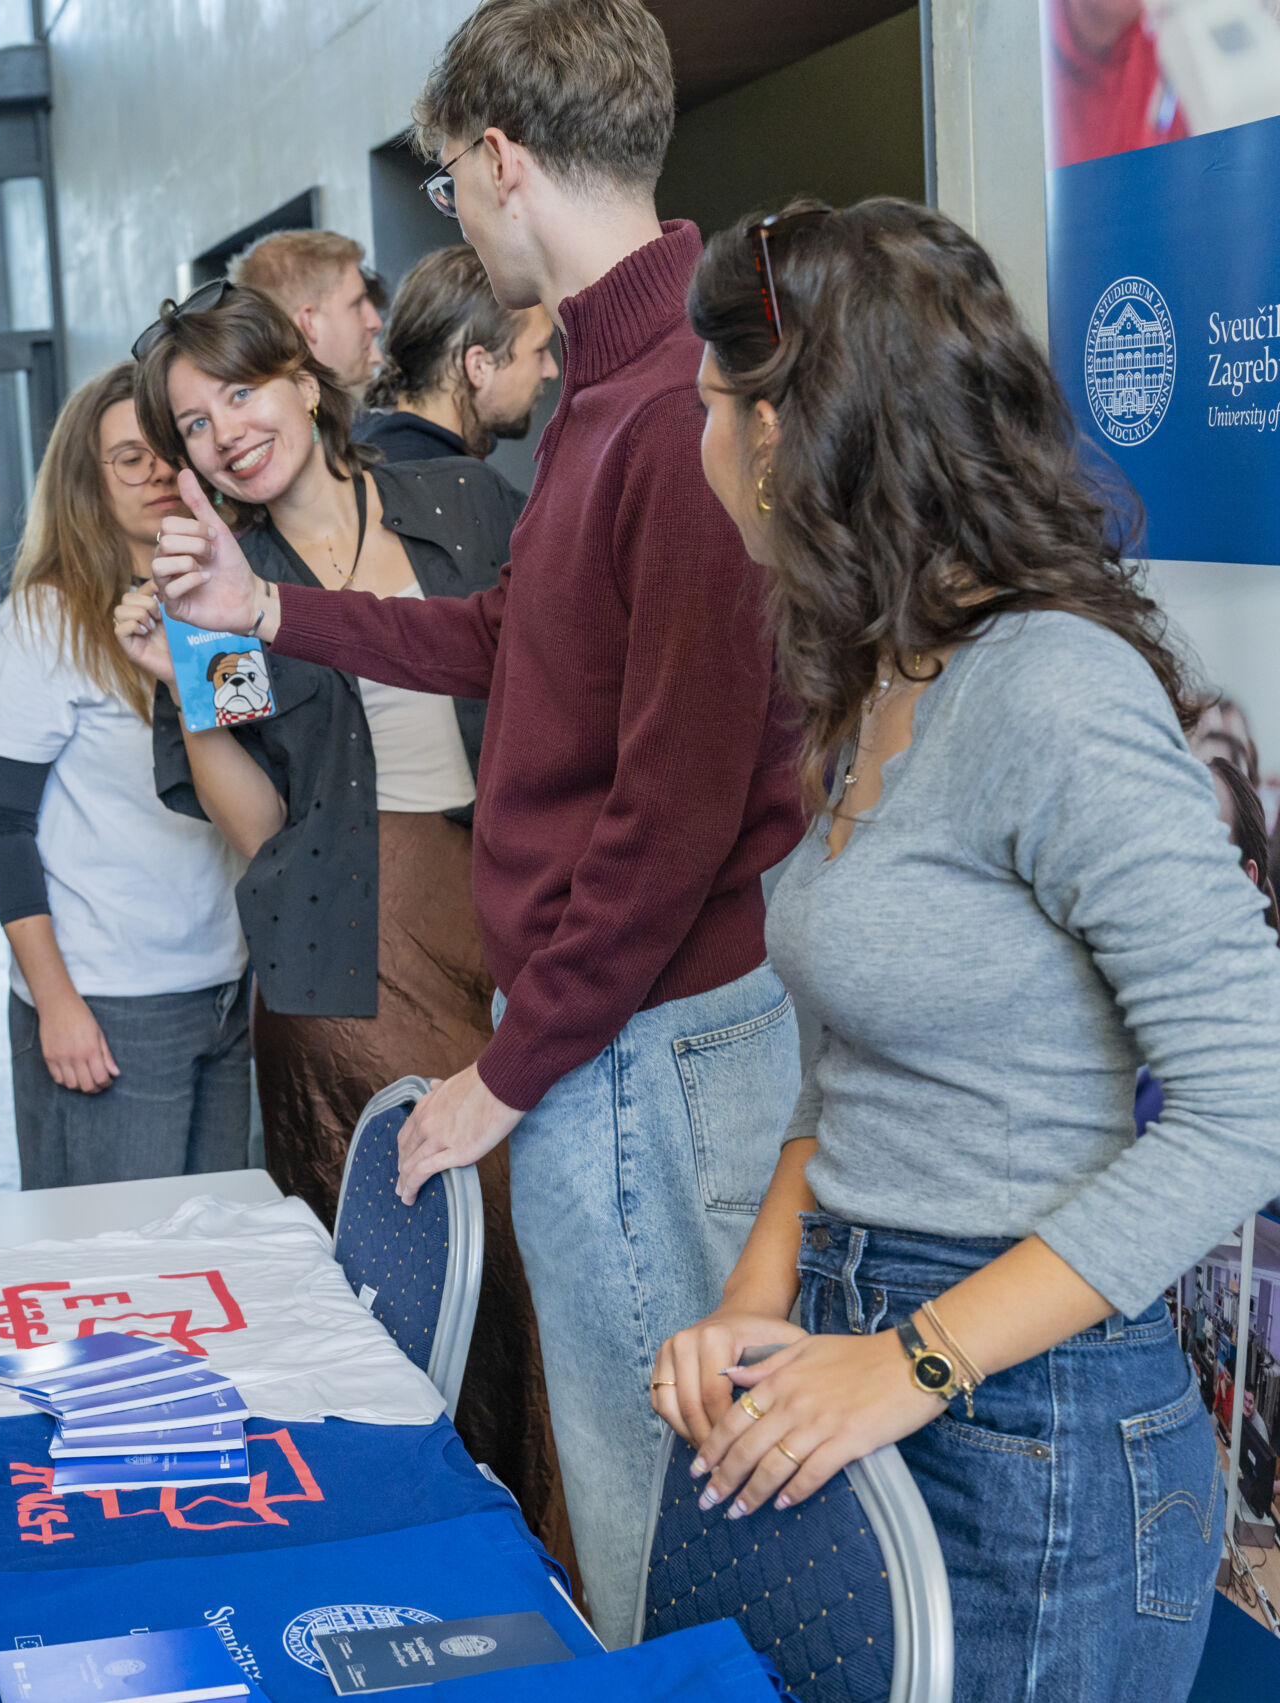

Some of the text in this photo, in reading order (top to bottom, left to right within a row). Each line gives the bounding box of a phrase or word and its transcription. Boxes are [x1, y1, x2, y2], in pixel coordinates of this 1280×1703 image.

[1099, 281, 1154, 318] STUDIORUM
[1087, 320, 1105, 422] UNIVERSITAS
[1153, 299, 1173, 419] ZAGRABIENSIS
[1208, 346, 1280, 397] Zagreb
[1106, 418, 1153, 441] MDCLXIX
[1208, 402, 1266, 432] University
